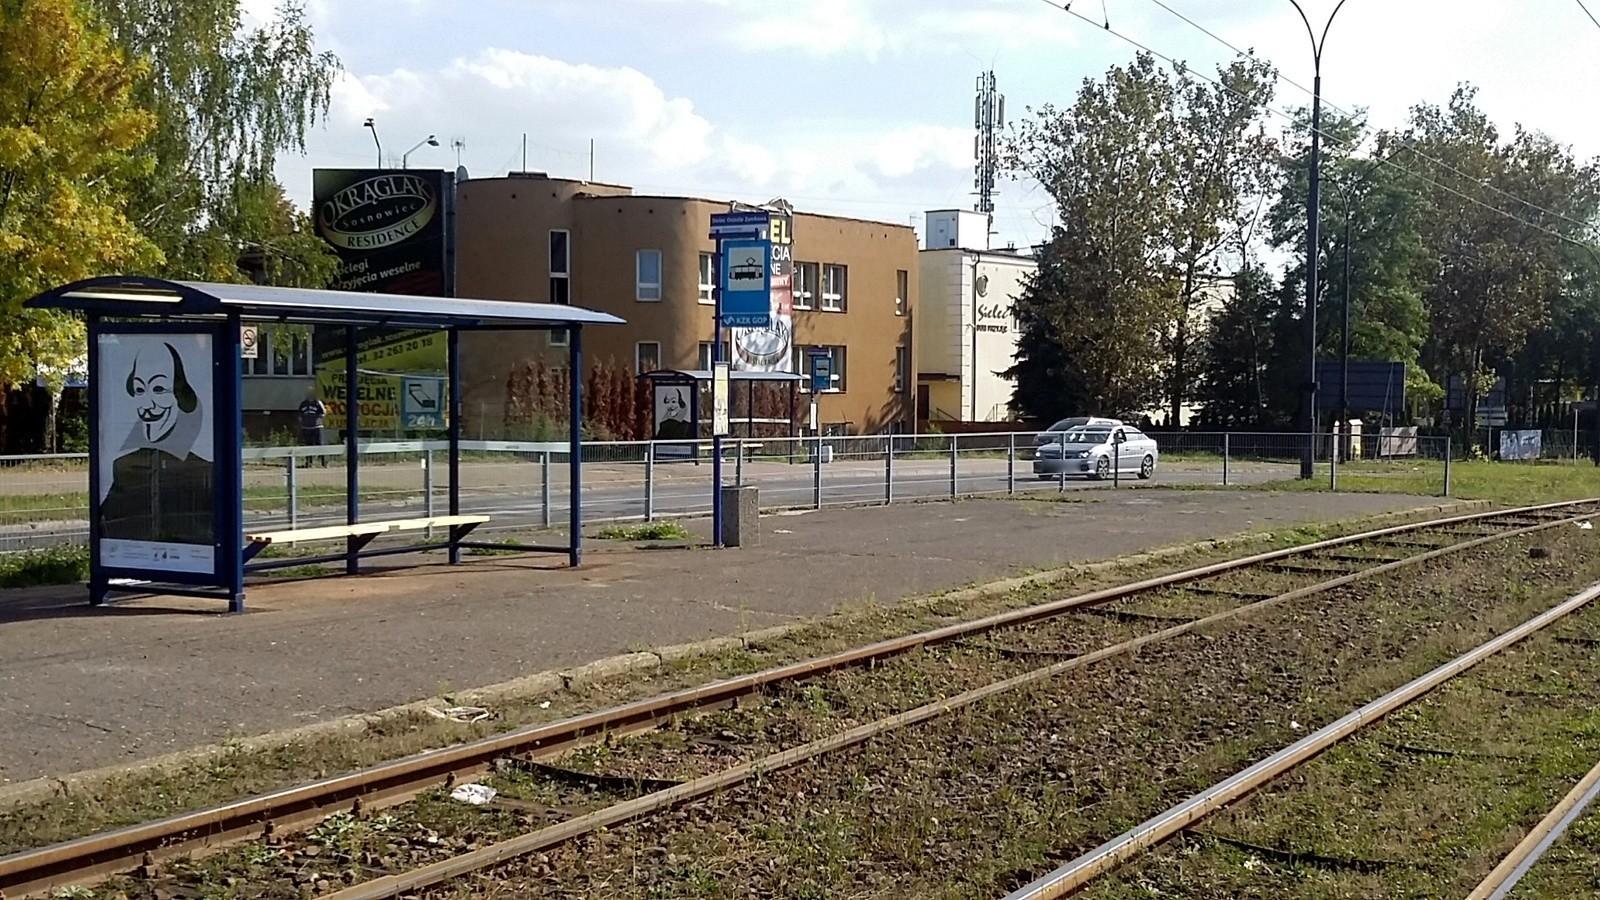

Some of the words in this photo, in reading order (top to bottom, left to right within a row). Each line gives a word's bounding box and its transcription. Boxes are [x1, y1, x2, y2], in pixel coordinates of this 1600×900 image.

[322, 176, 432, 226] OKRĄGLAK
[379, 260, 421, 279] weselne
[406, 340, 418, 352] 20
[323, 385, 397, 400] WEELNE
